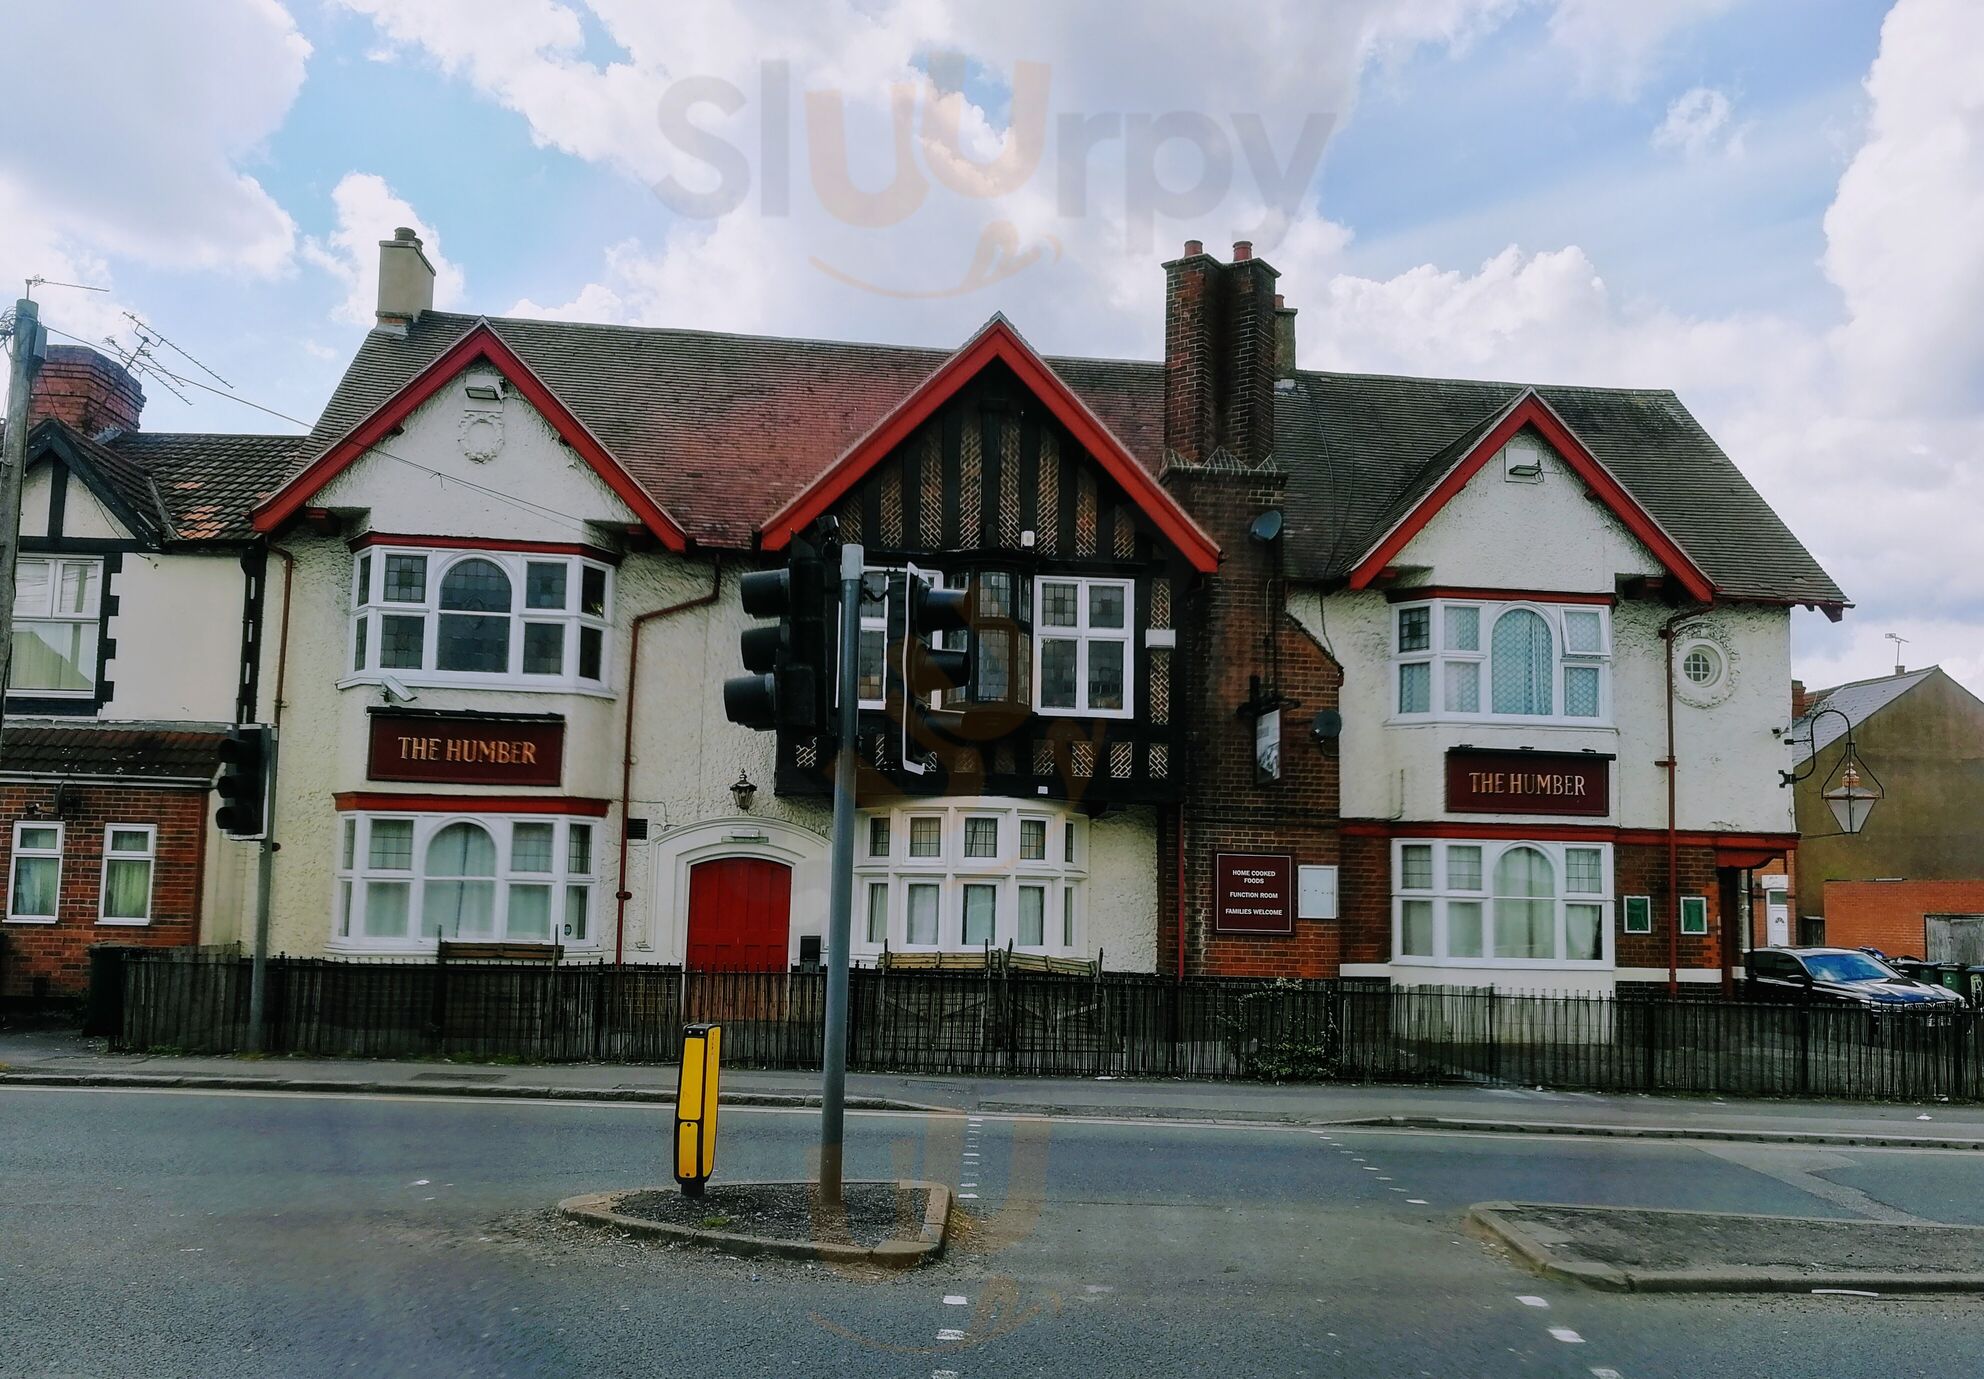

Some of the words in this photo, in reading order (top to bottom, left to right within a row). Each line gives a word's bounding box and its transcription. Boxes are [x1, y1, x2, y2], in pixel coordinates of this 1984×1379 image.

[398, 736, 442, 761] THE
[446, 739, 537, 764] HUMBER
[1469, 772, 1505, 794] THE
[1509, 773, 1586, 796] HUMBER
